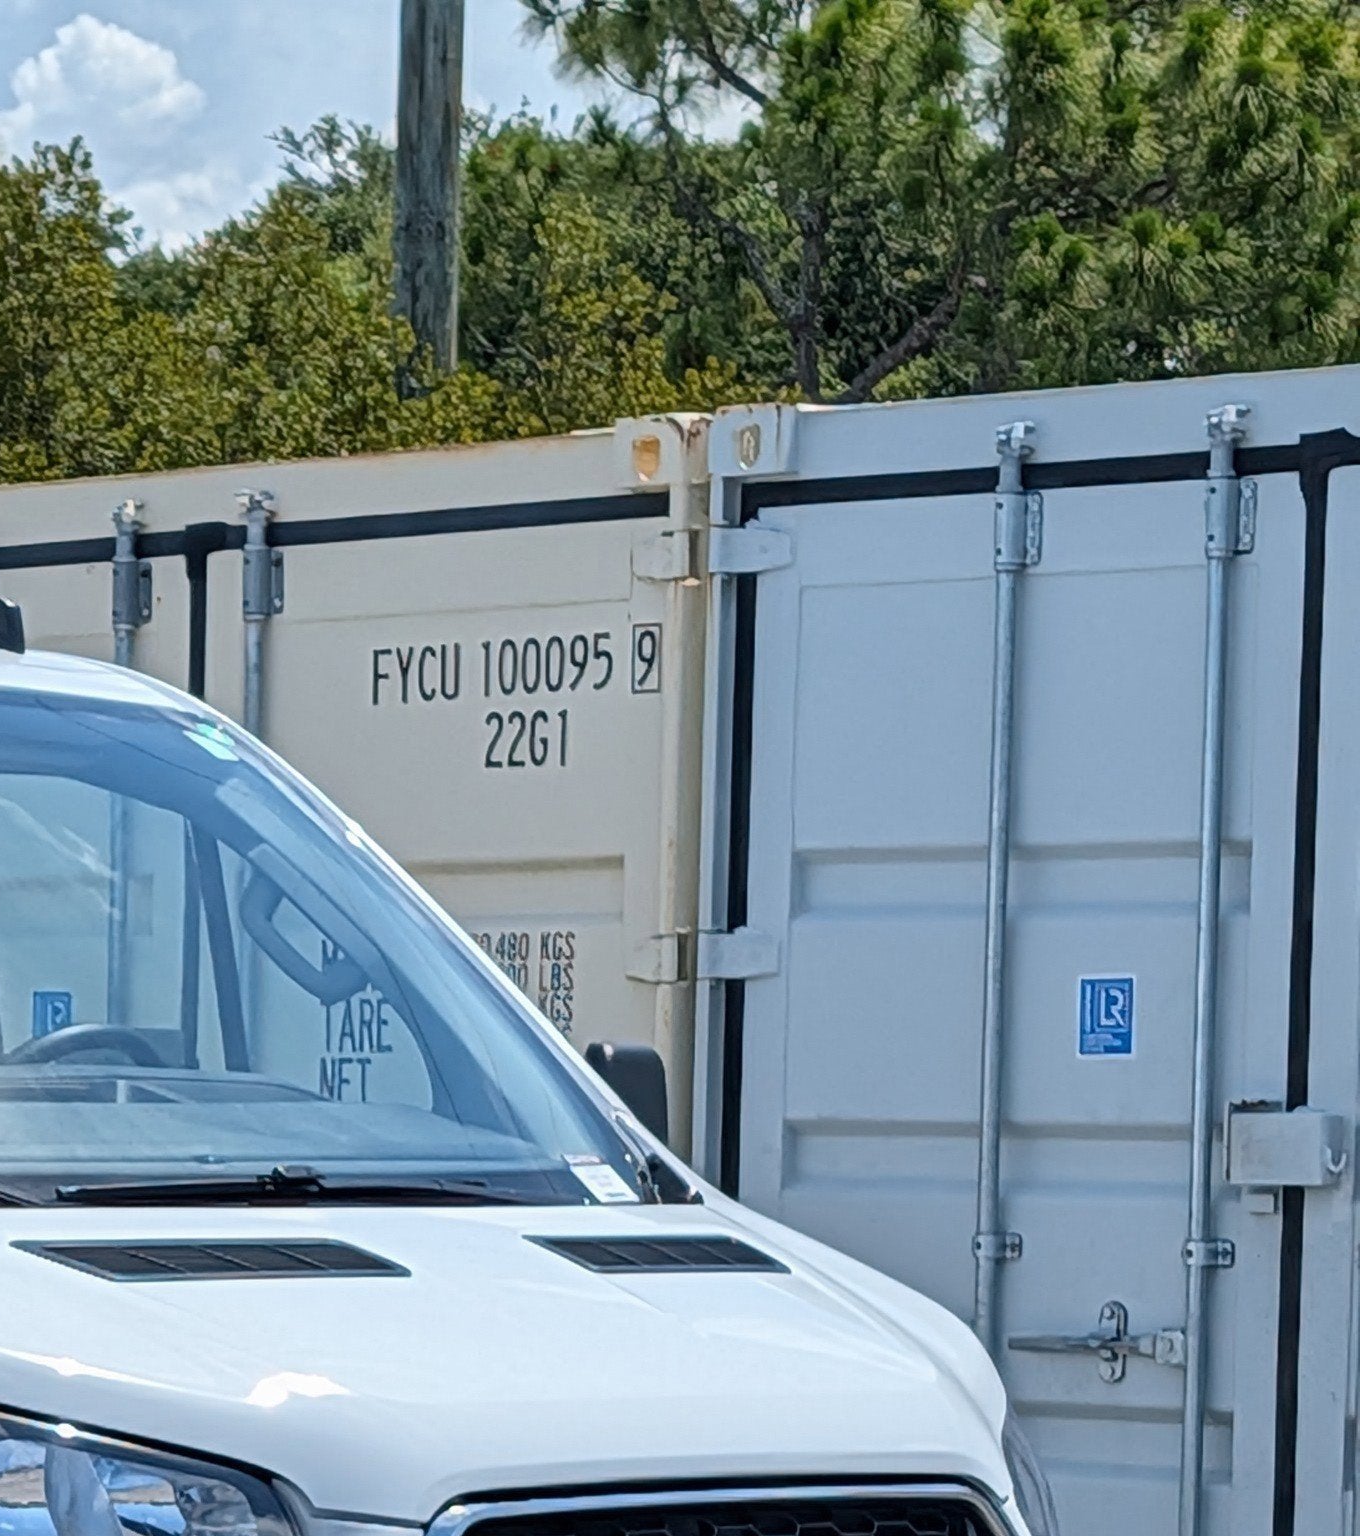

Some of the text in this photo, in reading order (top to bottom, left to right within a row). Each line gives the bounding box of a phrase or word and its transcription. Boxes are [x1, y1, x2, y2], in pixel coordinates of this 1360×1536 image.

[372, 641, 461, 706] FYCU
[481, 631, 614, 698] 100095
[484, 708, 568, 769] 22G1
[540, 931, 576, 961] KGS
[539, 961, 574, 992] LBS
[323, 998, 393, 1053] TARE
